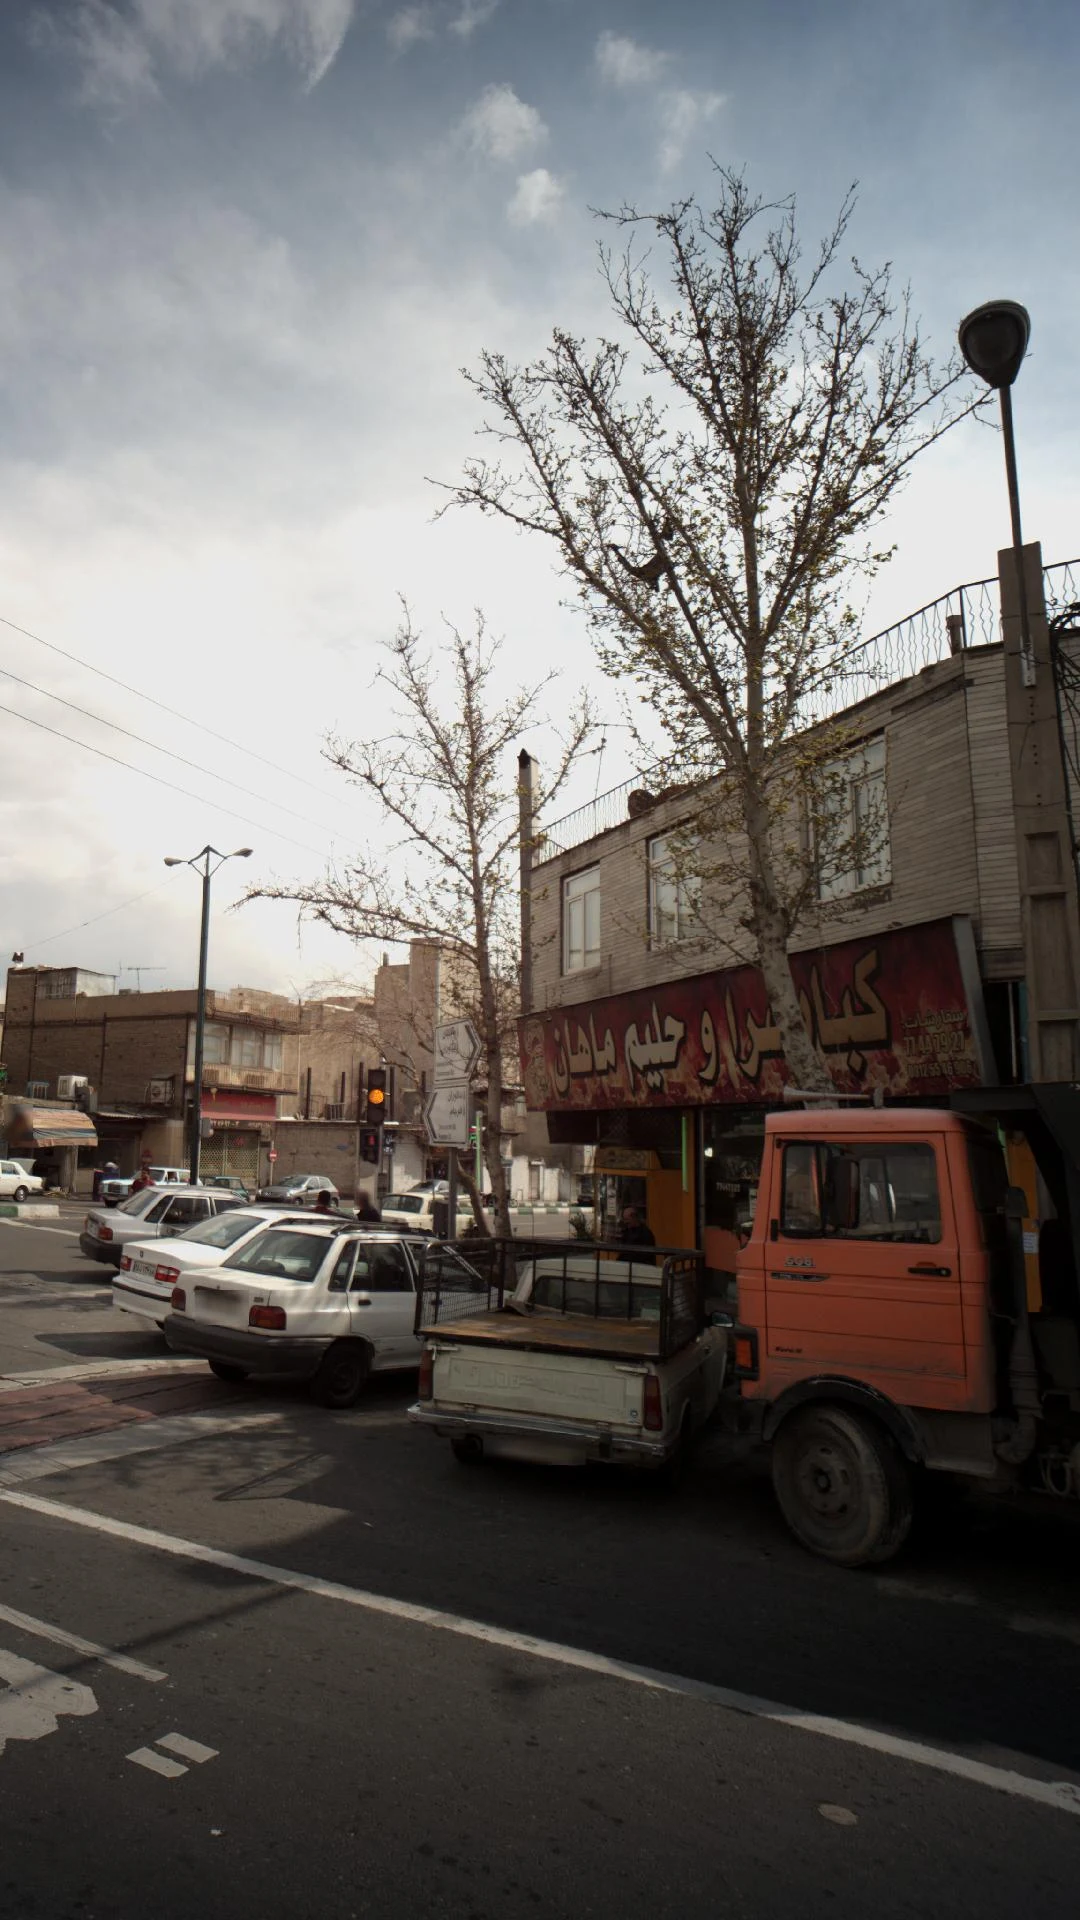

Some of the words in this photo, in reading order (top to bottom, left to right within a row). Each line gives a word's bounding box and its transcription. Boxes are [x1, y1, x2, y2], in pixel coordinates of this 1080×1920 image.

[552, 1013, 617, 1095] ماهان
[625, 1001, 687, 1092] حلیم
[698, 1009, 719, 1083] و
[903, 1008, 965, 1029] سفارشات
